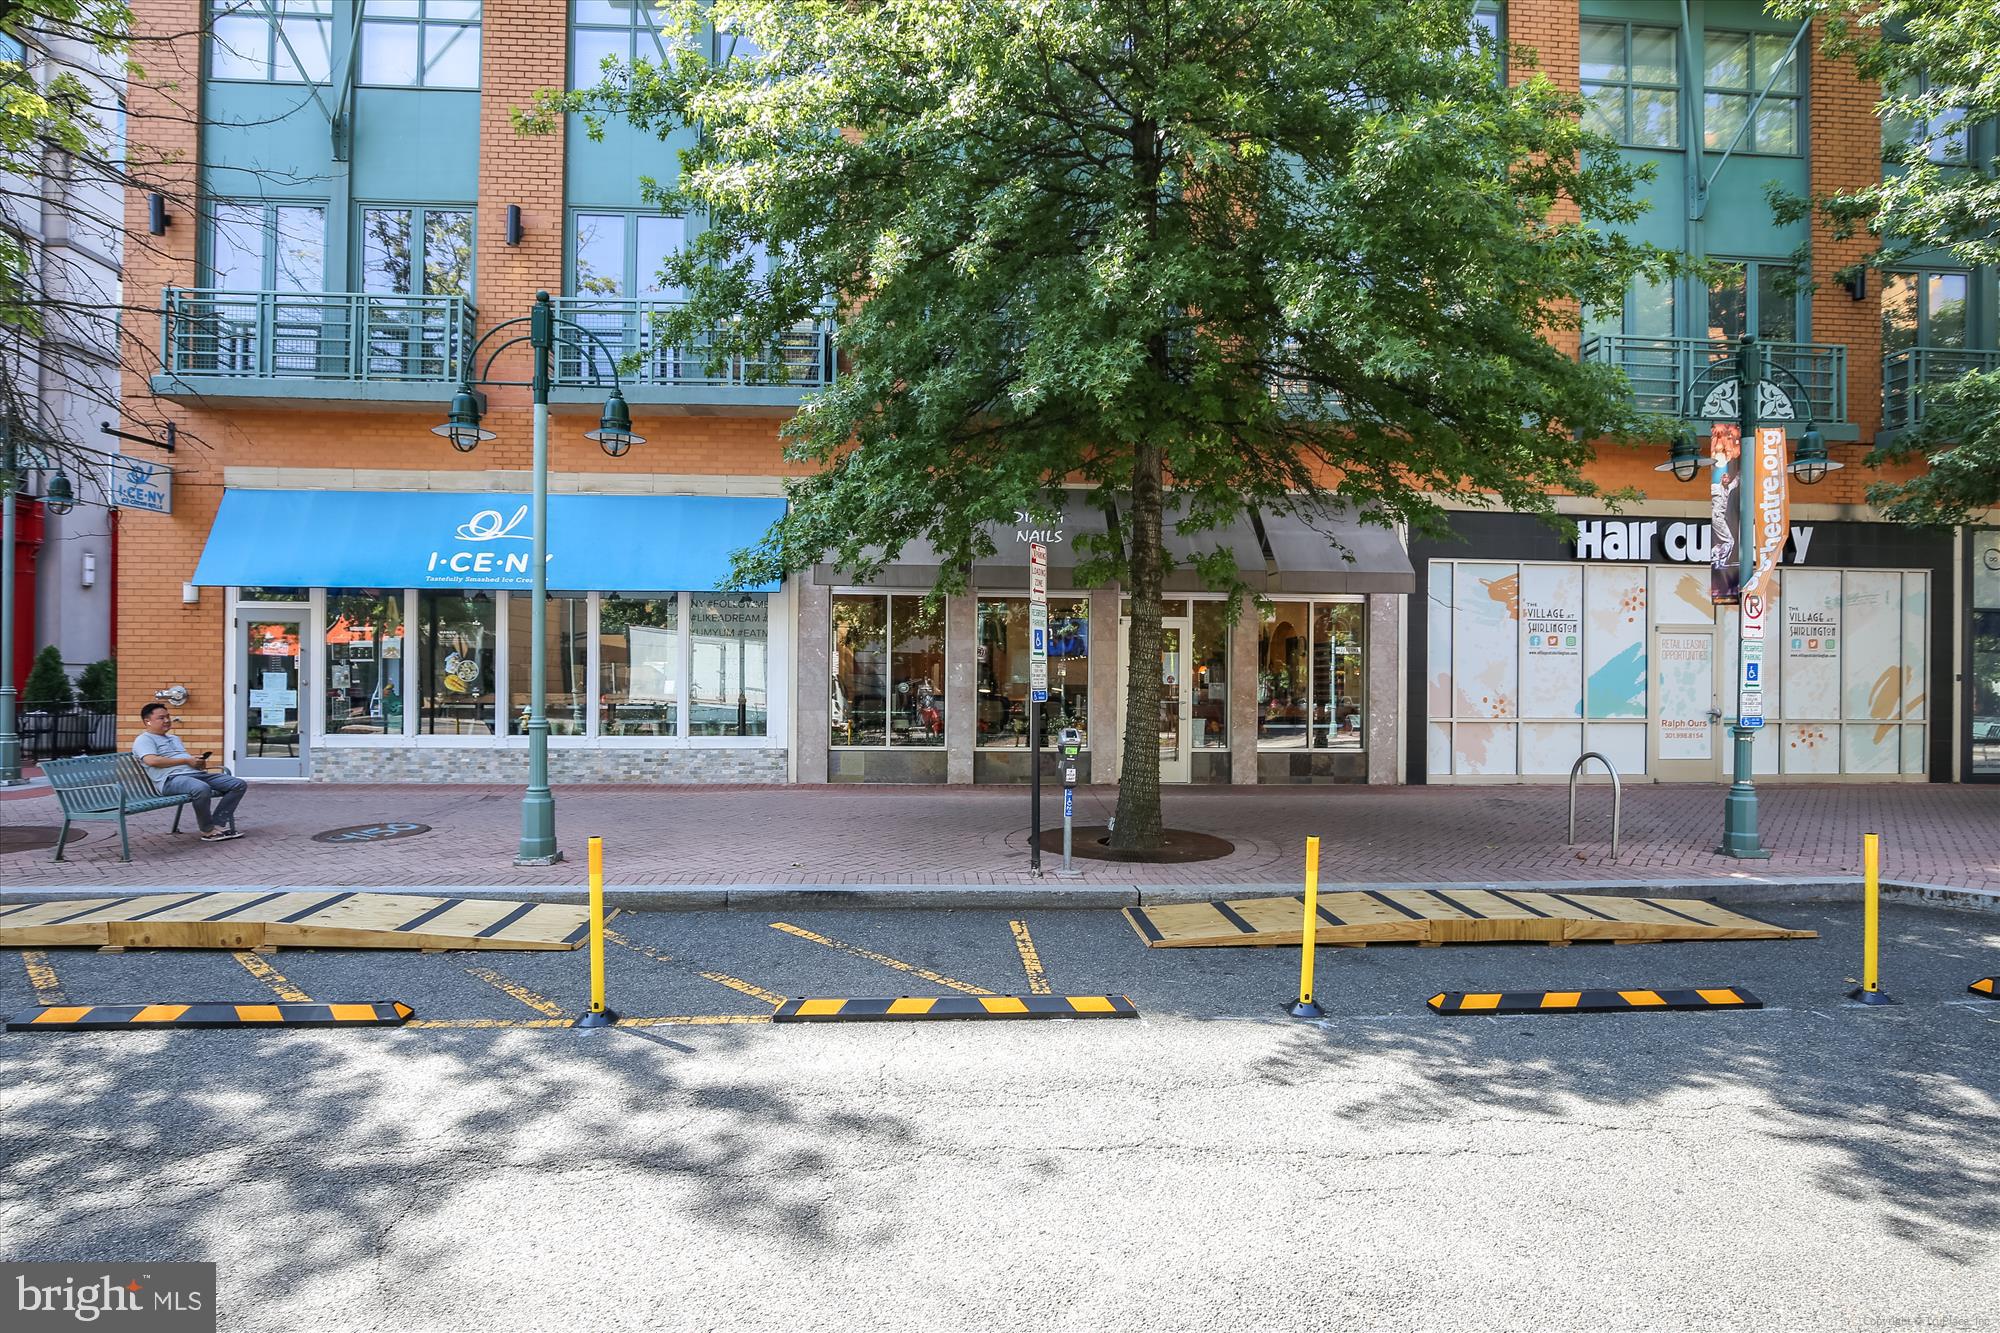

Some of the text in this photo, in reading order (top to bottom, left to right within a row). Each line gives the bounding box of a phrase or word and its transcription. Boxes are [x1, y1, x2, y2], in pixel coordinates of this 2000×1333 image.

[1016, 530, 1063, 543] NAILS
[1577, 520, 1657, 560] Hair
[425, 575, 464, 584] Tastefully
[691, 613, 760, 623] #LIKEADREAM
[1527, 608, 1565, 619] VILLAGE
[1789, 612, 1824, 622] VILLAGE
[1528, 622, 1577, 634] SHIRLINGTON
[1790, 626, 1836, 637] SHIRLINGTON
[1661, 639, 1708, 650] RETAIL LEASING
[1661, 650, 1708, 661] OPPORTUNITIES
[1661, 719, 1708, 729] Ralph Ours
